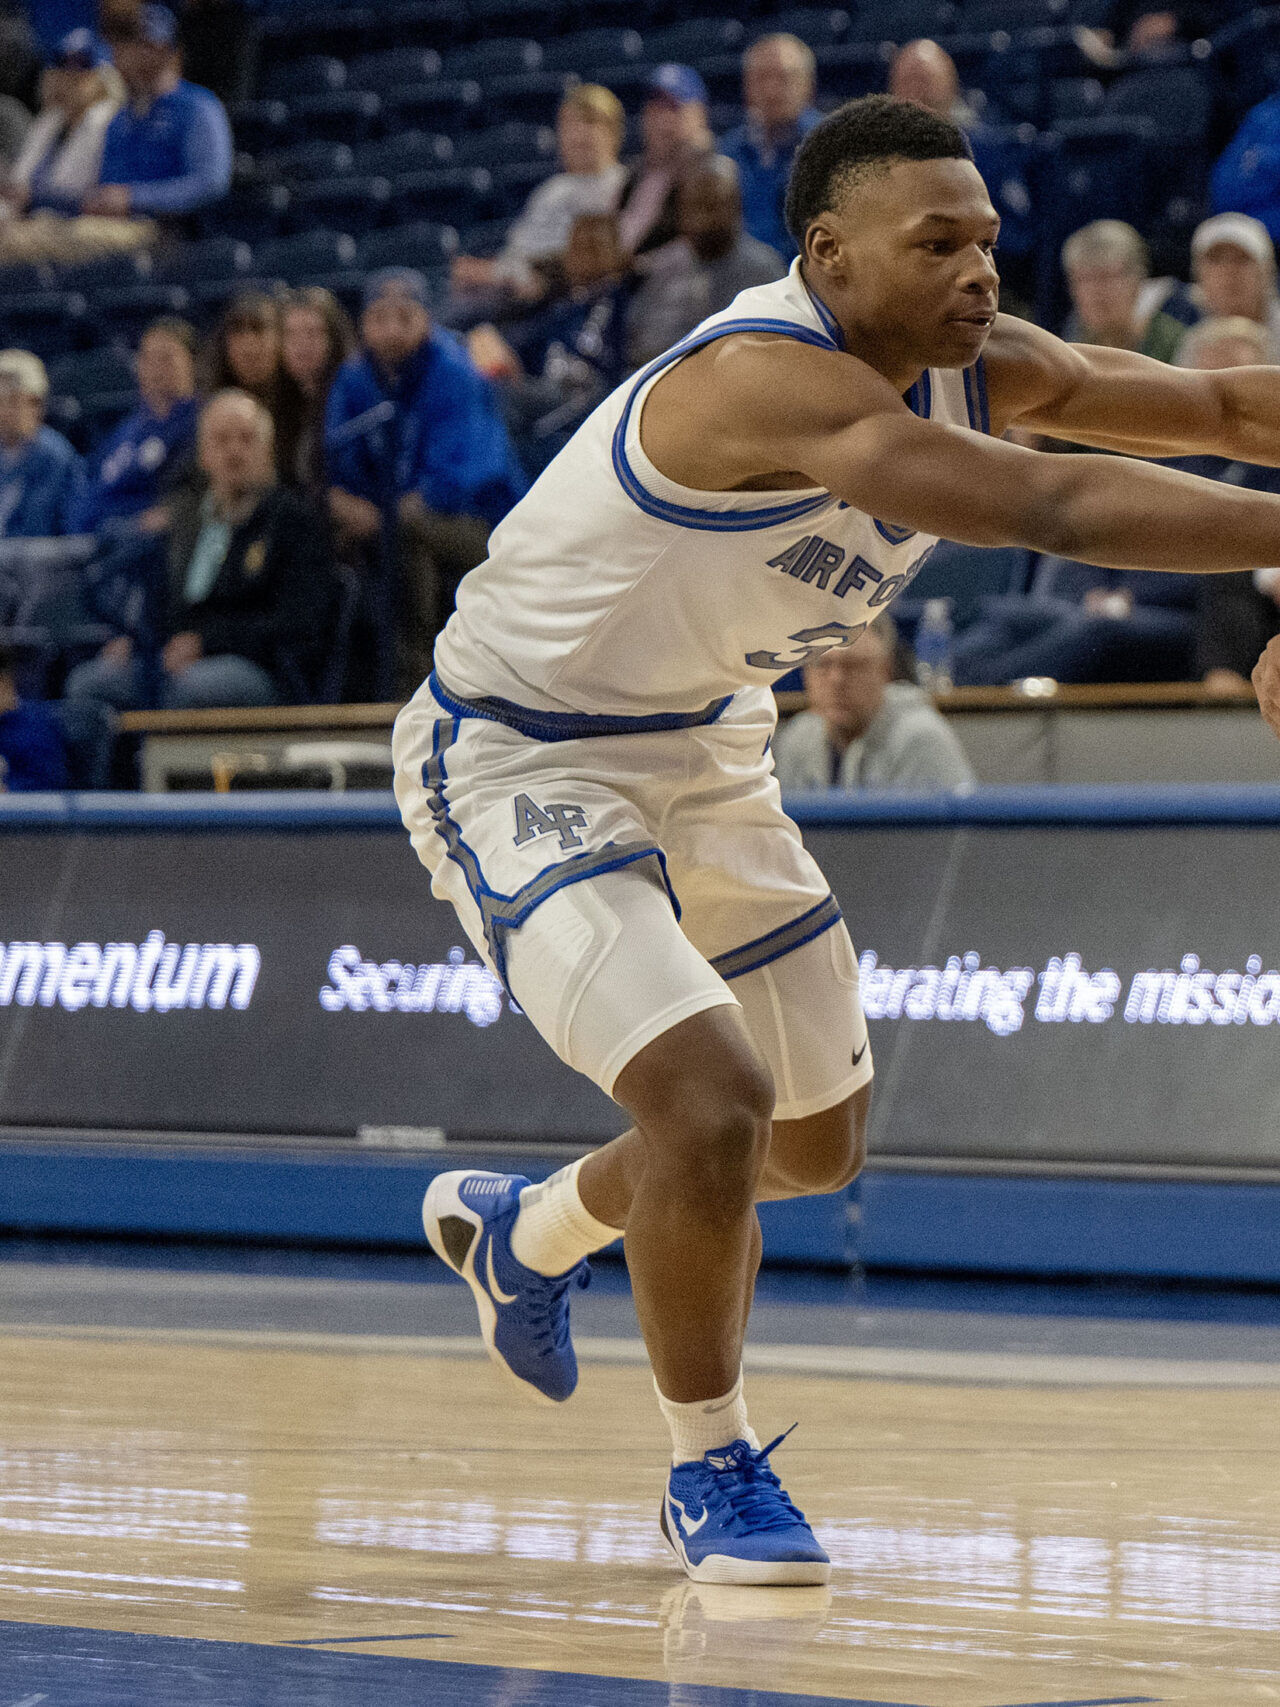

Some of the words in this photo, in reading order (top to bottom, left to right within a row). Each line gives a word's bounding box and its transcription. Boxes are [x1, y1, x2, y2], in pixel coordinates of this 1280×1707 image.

[765, 534, 846, 591] AIR
[512, 792, 588, 850] AF
[0, 929, 262, 1013] mentum
[318, 945, 504, 1028] Securing
[858, 949, 1035, 1037] lerating
[1034, 951, 1122, 1024] the
